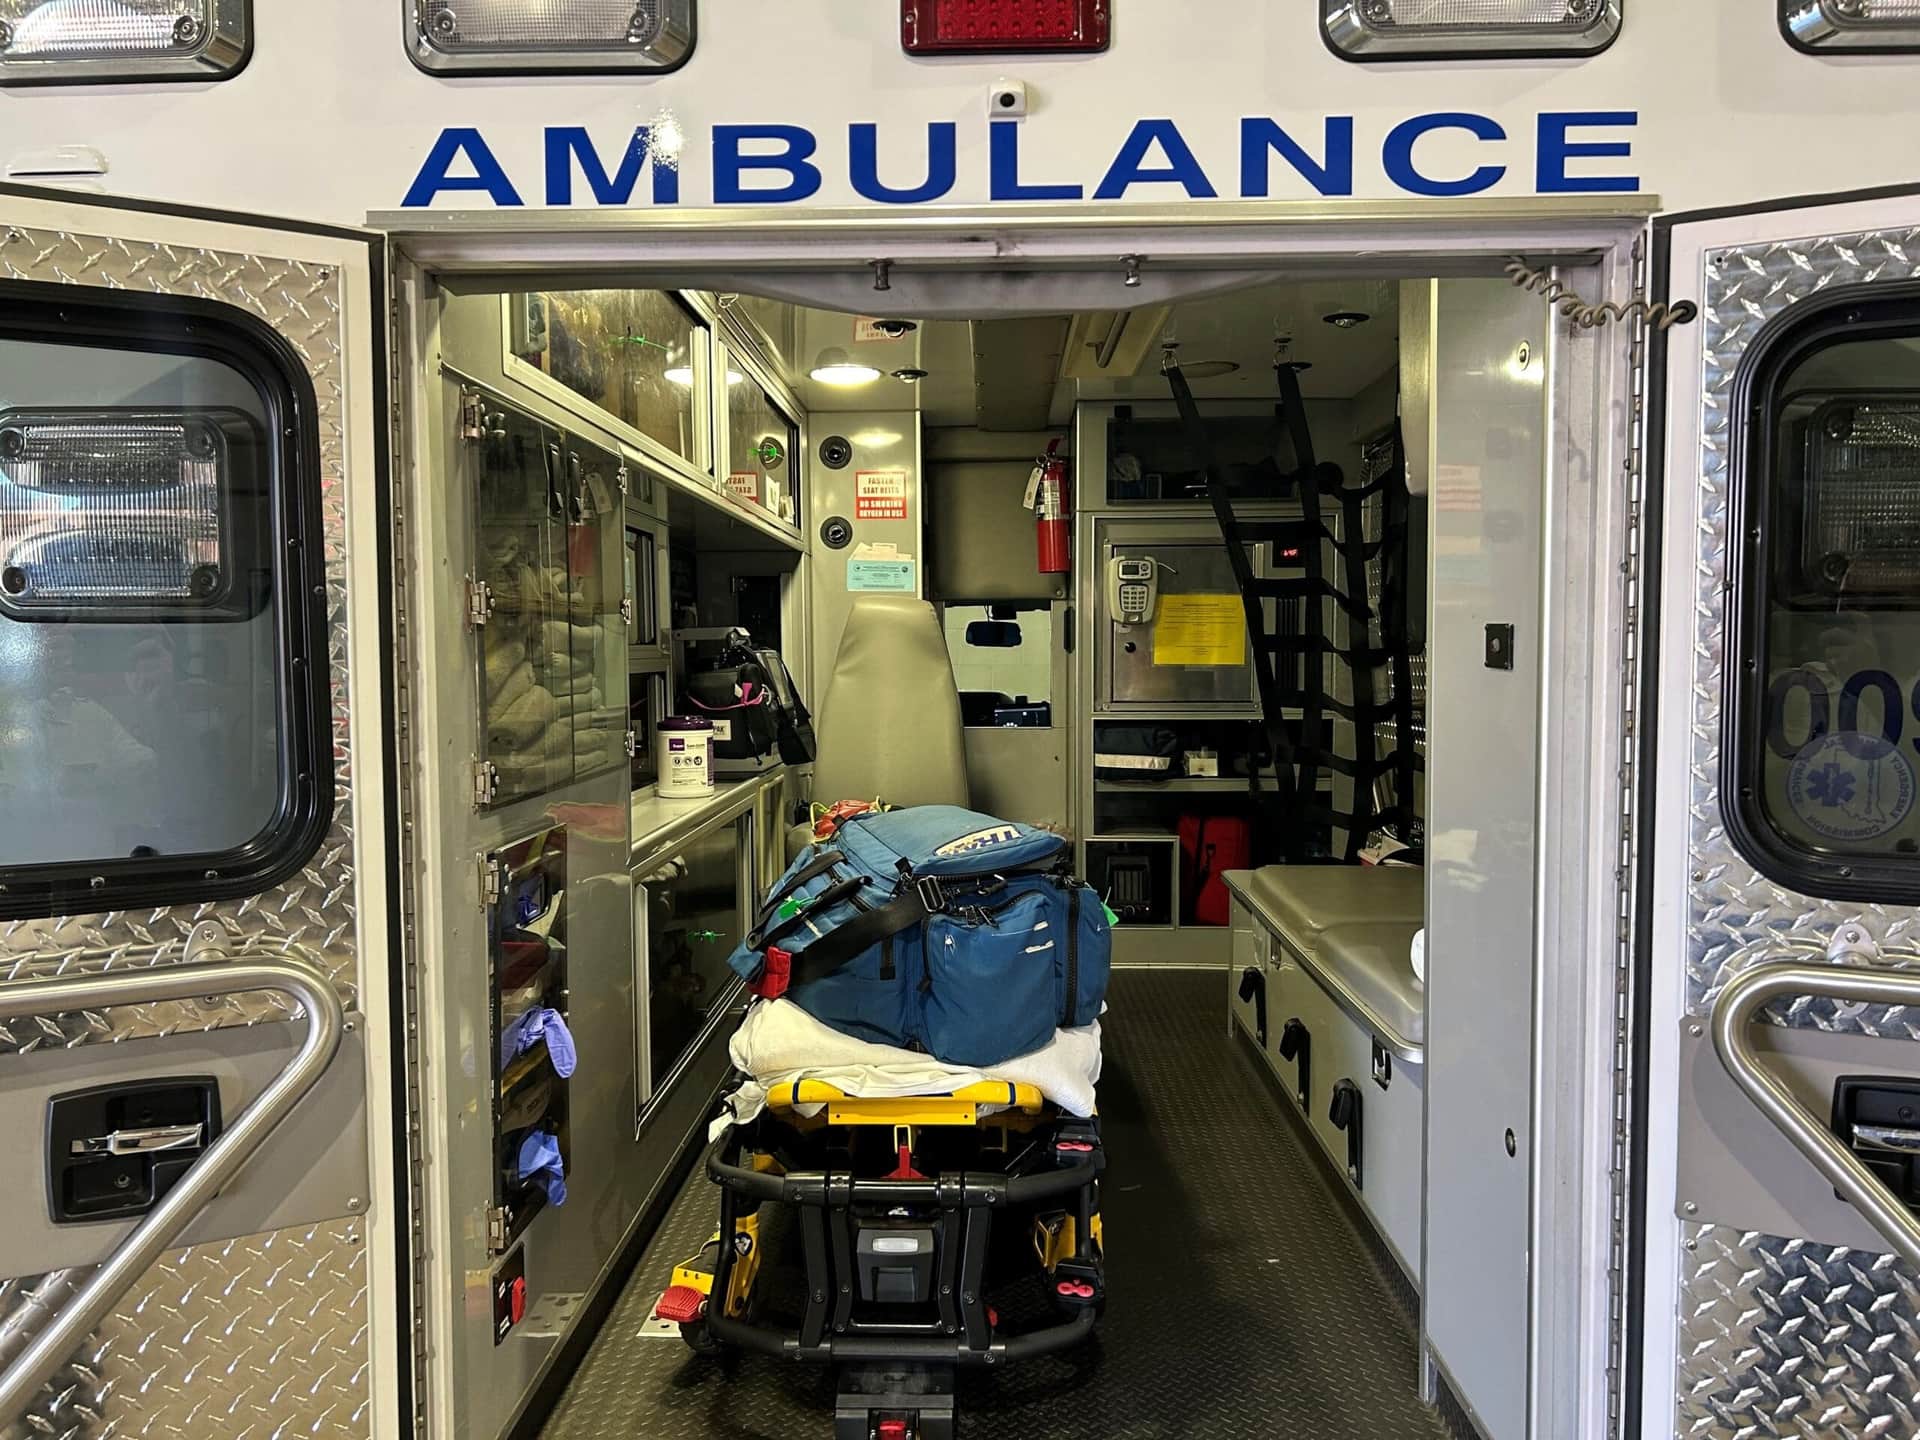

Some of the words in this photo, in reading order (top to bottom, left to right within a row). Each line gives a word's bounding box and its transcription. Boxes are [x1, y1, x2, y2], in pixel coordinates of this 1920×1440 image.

[401, 111, 1640, 207] AMBULANCE
[863, 486, 878, 494] SEAT
[859, 500, 870, 508] NO
[871, 500, 903, 508] SMOKING
[859, 509, 883, 517] OXYGEN
[892, 509, 904, 517] USE
[1766, 669, 1920, 761] 00
